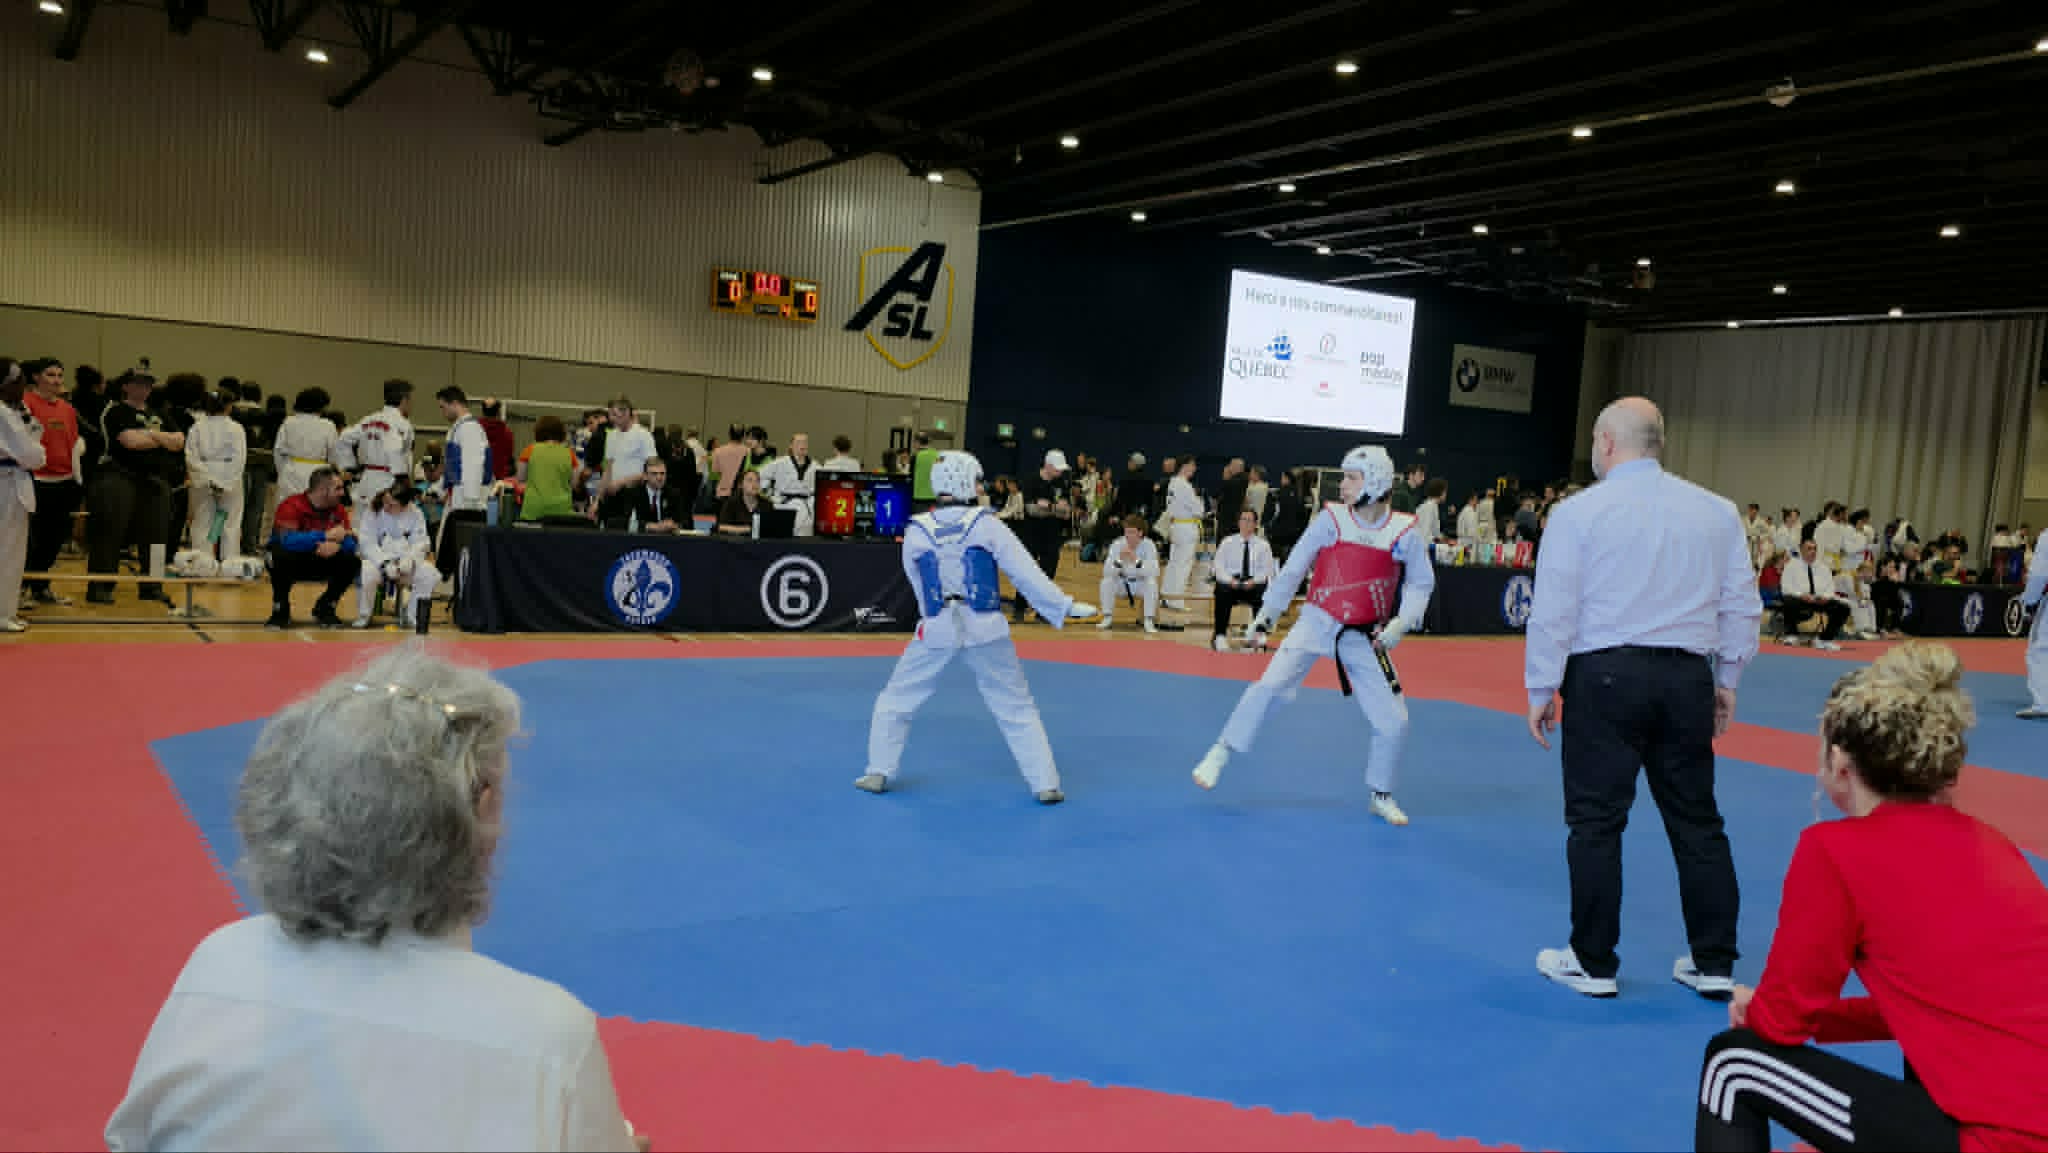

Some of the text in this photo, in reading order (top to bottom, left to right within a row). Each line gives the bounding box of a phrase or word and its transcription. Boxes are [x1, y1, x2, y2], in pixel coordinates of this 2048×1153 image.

[835, 498, 847, 517] 2
[882, 499, 892, 518] 1
[779, 570, 810, 615] 6
